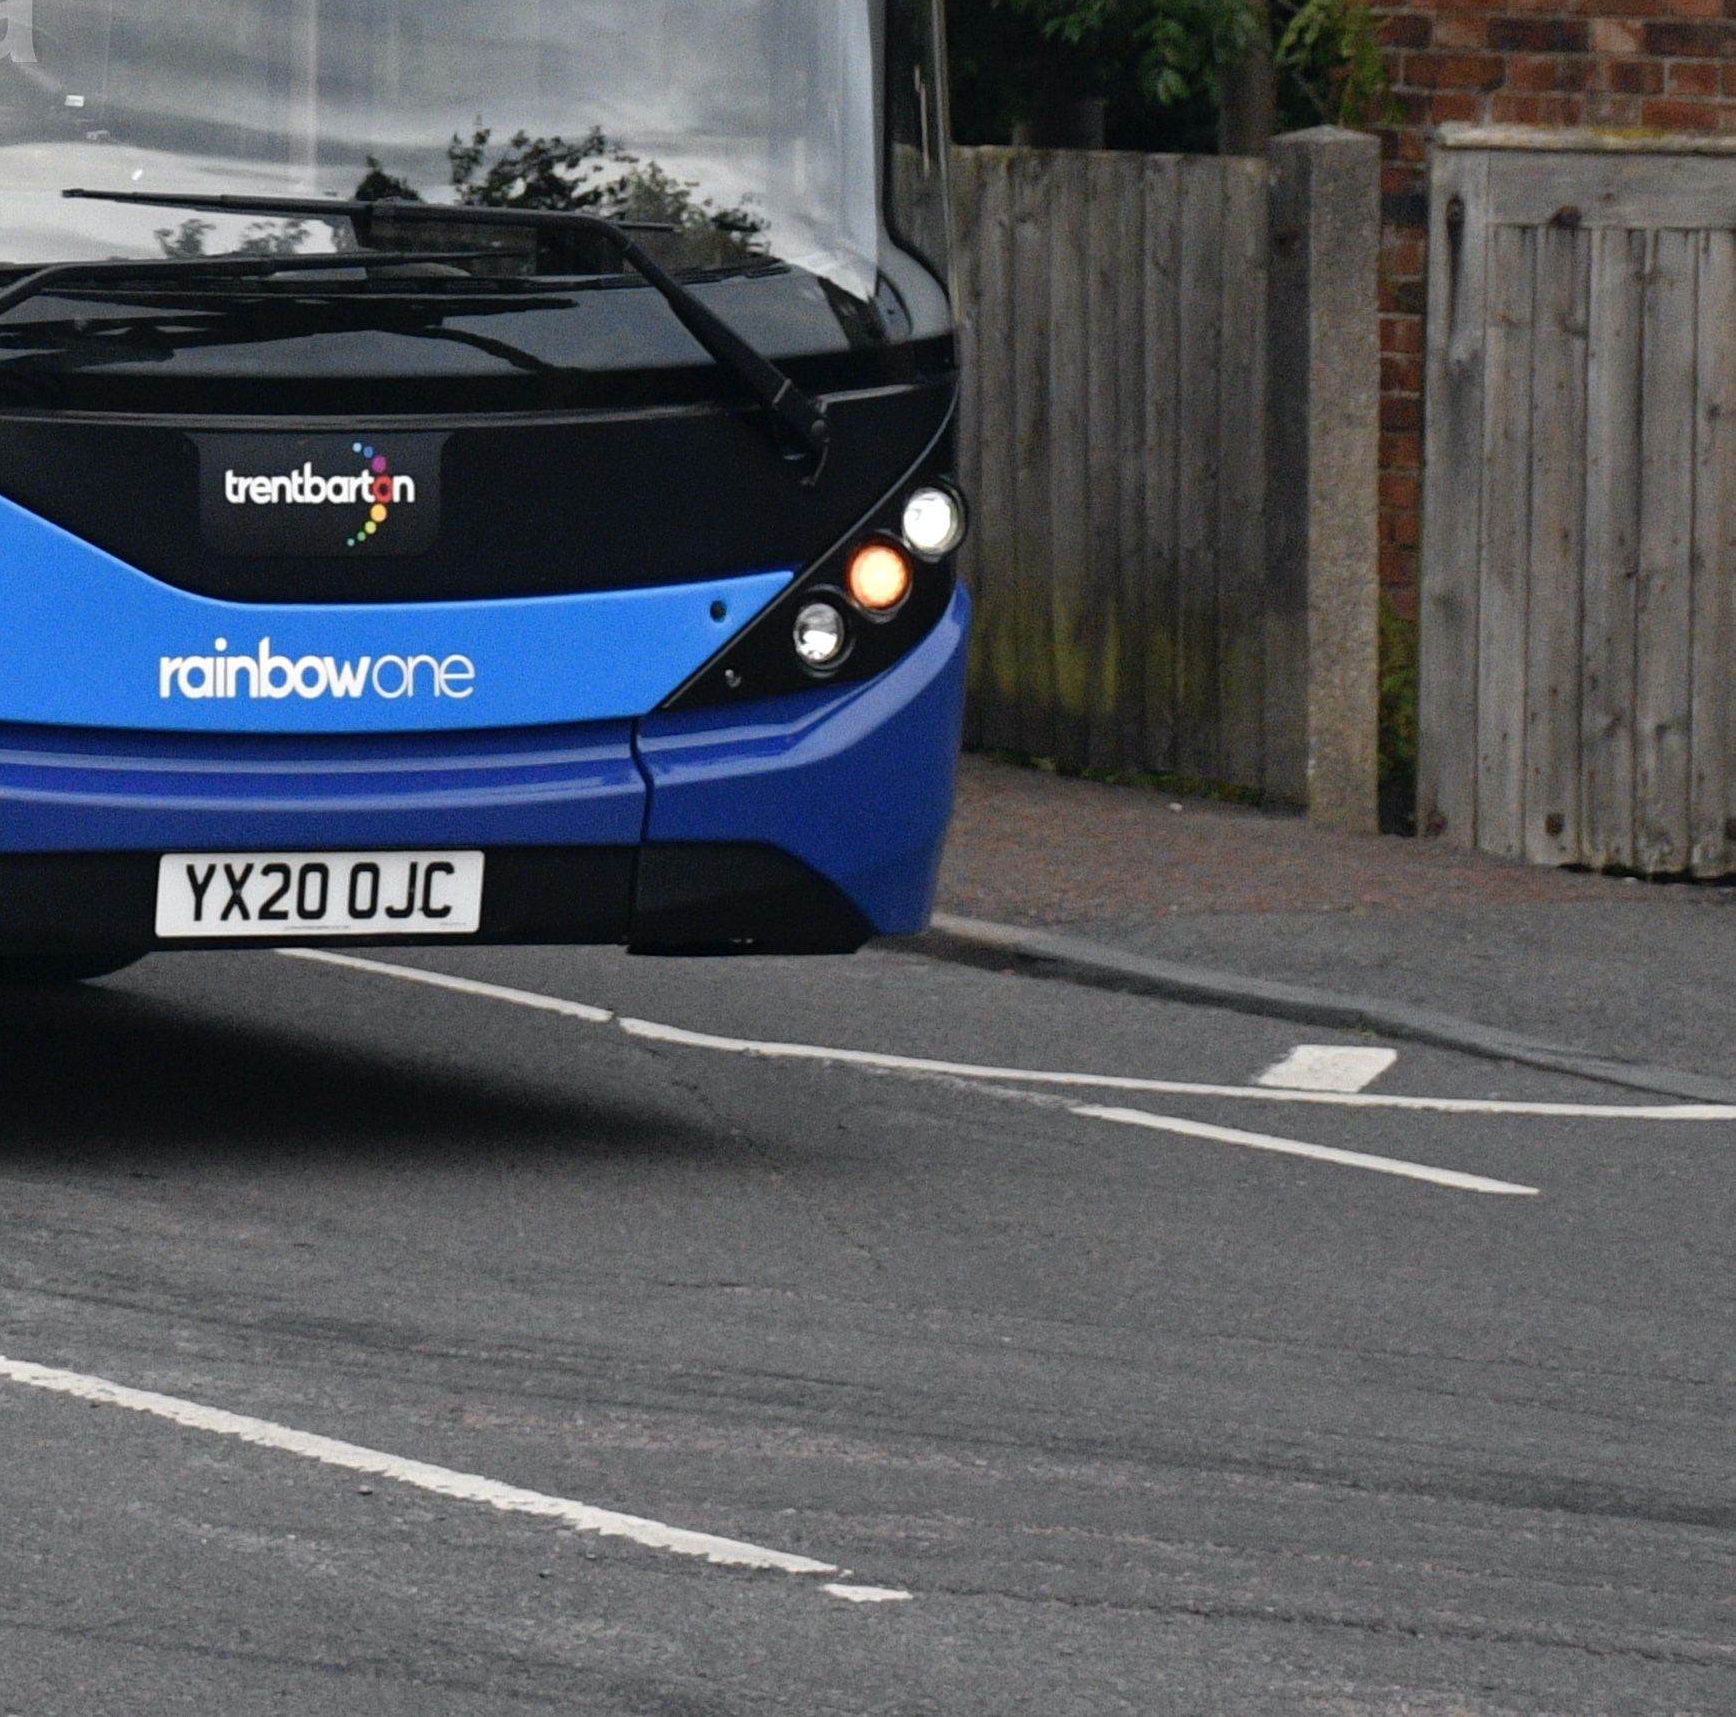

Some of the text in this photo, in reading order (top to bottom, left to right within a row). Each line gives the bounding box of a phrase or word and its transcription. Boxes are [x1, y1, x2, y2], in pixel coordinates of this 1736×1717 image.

[224, 461, 415, 506] trentbarton
[185, 861, 455, 922] YX20 OJC
